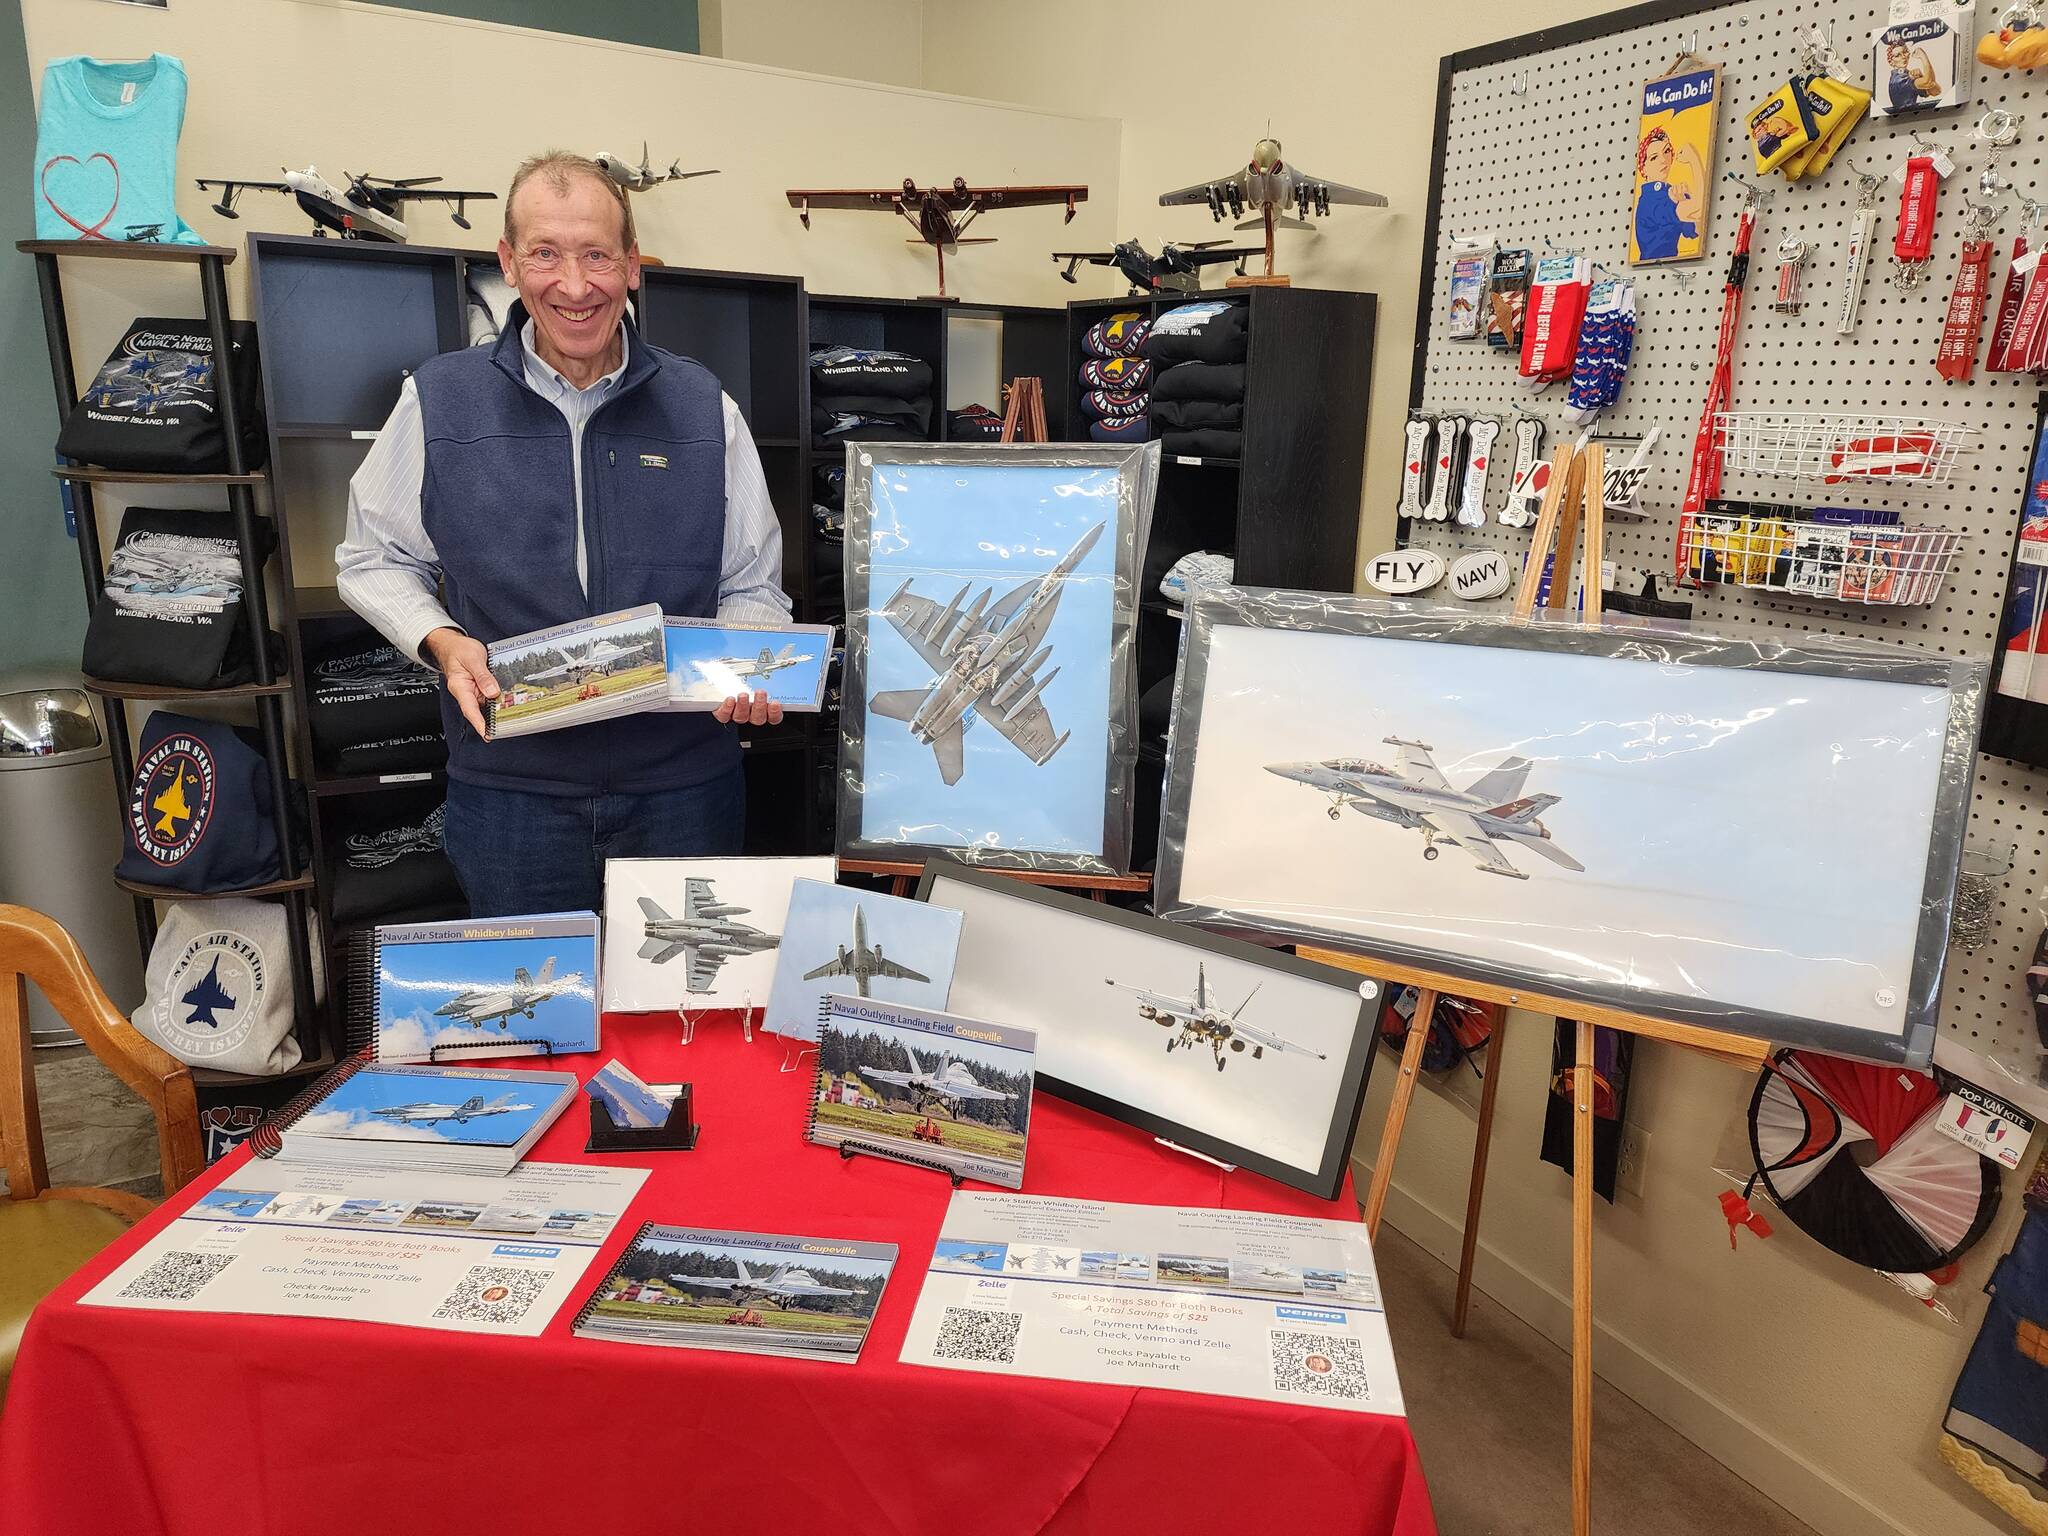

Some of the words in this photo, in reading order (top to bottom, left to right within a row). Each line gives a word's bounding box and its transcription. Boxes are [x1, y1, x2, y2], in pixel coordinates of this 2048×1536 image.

[1887, 31, 1900, 42] We
[1901, 28, 1918, 39] Can
[1920, 24, 1932, 35] Do
[1934, 22, 1944, 32] It!
[1646, 92, 1660, 107] We
[1663, 87, 1682, 103] Can
[1683, 83, 1697, 98] Do
[1699, 77, 1713, 95] It!
[1908, 200, 1920, 223] BEFORE
[1963, 264, 1977, 293] REMOVE
[1538, 286, 1557, 313] REMOVE
[1948, 295, 1961, 324] BEFORE
[1957, 296, 1974, 325] BEFORE
[2013, 326, 2031, 351] REMOVE
[2022, 302, 2039, 326] BEFORE
[2031, 280, 2046, 303] FLIGHT
[1535, 313, 1550, 343] BEFORE
[1998, 300, 2019, 348] FORCE
[136, 340, 171, 348] NAVAL
[171, 341, 190, 350] AIR
[141, 332, 180, 341] PACIFIC
[822, 366, 861, 375] WHIDBEY
[863, 365, 893, 374] ISLAND,
[86, 410, 130, 423] WHIDBEY
[130, 415, 164, 426] ISLAND,
[1408, 440, 1420, 459] Dog
[1473, 440, 1487, 455] Dog
[1405, 492, 1416, 513] Navy
[1375, 562, 1425, 583] FLY
[1457, 560, 1498, 590] NAVY
[115, 608, 154, 619] WHIDBEY
[156, 613, 194, 624] ISLAND,
[197, 616, 212, 625] WA
[494, 641, 515, 652] Naval
[516, 633, 547, 648] Outlying
[547, 626, 575, 640] Landing
[575, 622, 593, 632] Field
[328, 650, 373, 667] PACIFIC
[319, 692, 380, 704] WHIDBEY
[138, 744, 171, 783] NAVAL
[173, 740, 191, 752] AIR
[192, 745, 212, 802] STATION
[132, 800, 168, 861] WHIDBEY
[169, 820, 201, 861] ISLAND
[383, 931, 411, 942] Naval
[413, 931, 427, 940] Air
[429, 930, 462, 939] Station
[463, 928, 505, 939] Whidbey
[507, 927, 534, 937] Island
[173, 941, 202, 978] NAVAL
[207, 935, 228, 946] AIR
[230, 939, 263, 991] STATION
[834, 1003, 858, 1015] Naval
[859, 1007, 896, 1023] Outlying
[897, 1015, 931, 1030] Landing
[932, 1021, 954, 1033] Field
[955, 1025, 1002, 1043] Coupeville
[552, 1040, 586, 1048] Manhardt
[1959, 1088, 1982, 1102] POP
[2003, 1112, 2028, 1128] KITE
[963, 1162, 976, 1171] Joe
[976, 1164, 1009, 1178] Manhardt
[216, 1225, 247, 1233] Zelle
[281, 1234, 320, 1244] Special
[321, 1237, 362, 1247] Savings
[402, 1242, 426, 1250] Both
[429, 1245, 461, 1253] Books
[499, 1246, 557, 1255] venmo
[654, 1230, 685, 1240] Naval
[686, 1233, 730, 1245] Outlying
[732, 1238, 773, 1249] Landing
[774, 1241, 800, 1250] Field
[801, 1243, 857, 1255] Coupeville
[345, 1248, 384, 1258] Savings
[302, 1258, 350, 1267] Payment
[352, 1261, 401, 1271] Methods
[261, 1266, 290, 1275] Cash,
[332, 1270, 370, 1278] Venmo
[371, 1273, 395, 1281] and
[396, 1275, 422, 1283] Zelle
[282, 1282, 316, 1290] Checks
[319, 1284, 357, 1293] Payable
[977, 1279, 1007, 1289] Zelle
[282, 1292, 300, 1300] Joe
[303, 1293, 353, 1302] Manhardt
[1050, 1291, 1090, 1302] Special
[1093, 1295, 1134, 1306] Savings
[1137, 1298, 1158, 1307] $80
[1161, 1300, 1177, 1308] for
[1181, 1302, 1206, 1311] Both
[1210, 1306, 1244, 1315] Books
[1096, 1306, 1125, 1315] Total
[1127, 1308, 1169, 1319] Savings
[1172, 1312, 1185, 1321] of
[1187, 1313, 1208, 1322] $25
[1279, 1308, 1343, 1319] venmo
[1093, 1319, 1143, 1330] Payment
[1146, 1323, 1198, 1335] Methods
[1059, 1327, 1089, 1337] Cash,
[1093, 1330, 1131, 1341] Check,
[1134, 1334, 1176, 1344] Venmo
[1179, 1336, 1200, 1346] and
[1203, 1339, 1232, 1350] Zelle
[1097, 1347, 1134, 1357] Checks
[1136, 1350, 1178, 1361] Payable
[1180, 1354, 1191, 1362] to
[1106, 1358, 1124, 1367] Joe
[1127, 1361, 1181, 1371] Manhardt
